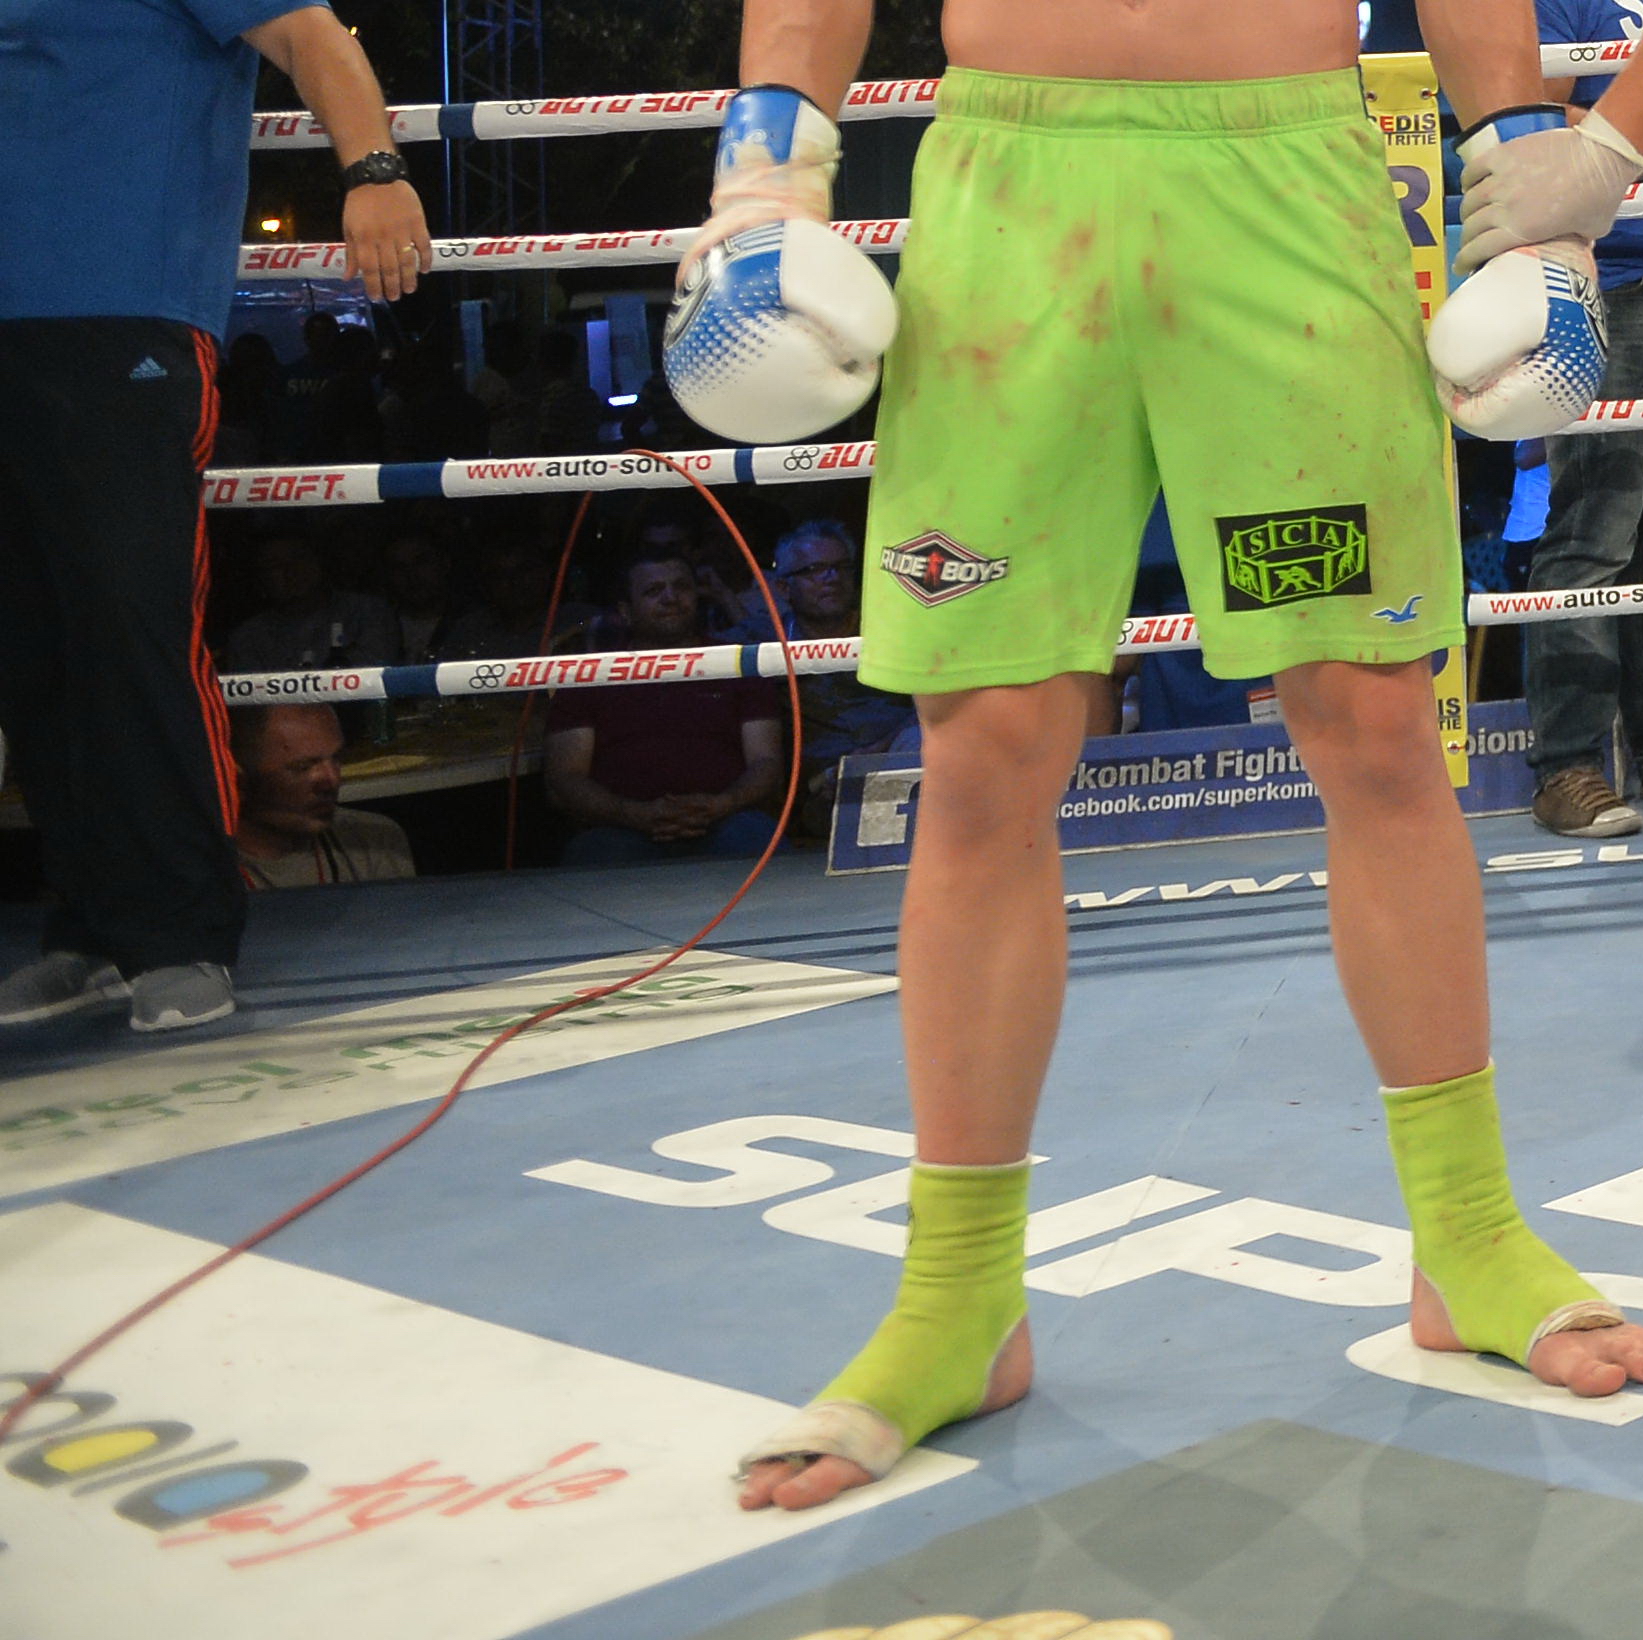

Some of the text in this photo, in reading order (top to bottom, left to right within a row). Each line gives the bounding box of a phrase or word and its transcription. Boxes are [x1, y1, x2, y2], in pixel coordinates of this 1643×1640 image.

[245, 245, 334, 269] SOFT
[248, 474, 344, 501] SOFT
[881, 546, 1008, 583] RUDE BOYS
[506, 660, 601, 687] AUTO
[608, 653, 703, 680] SOFT
